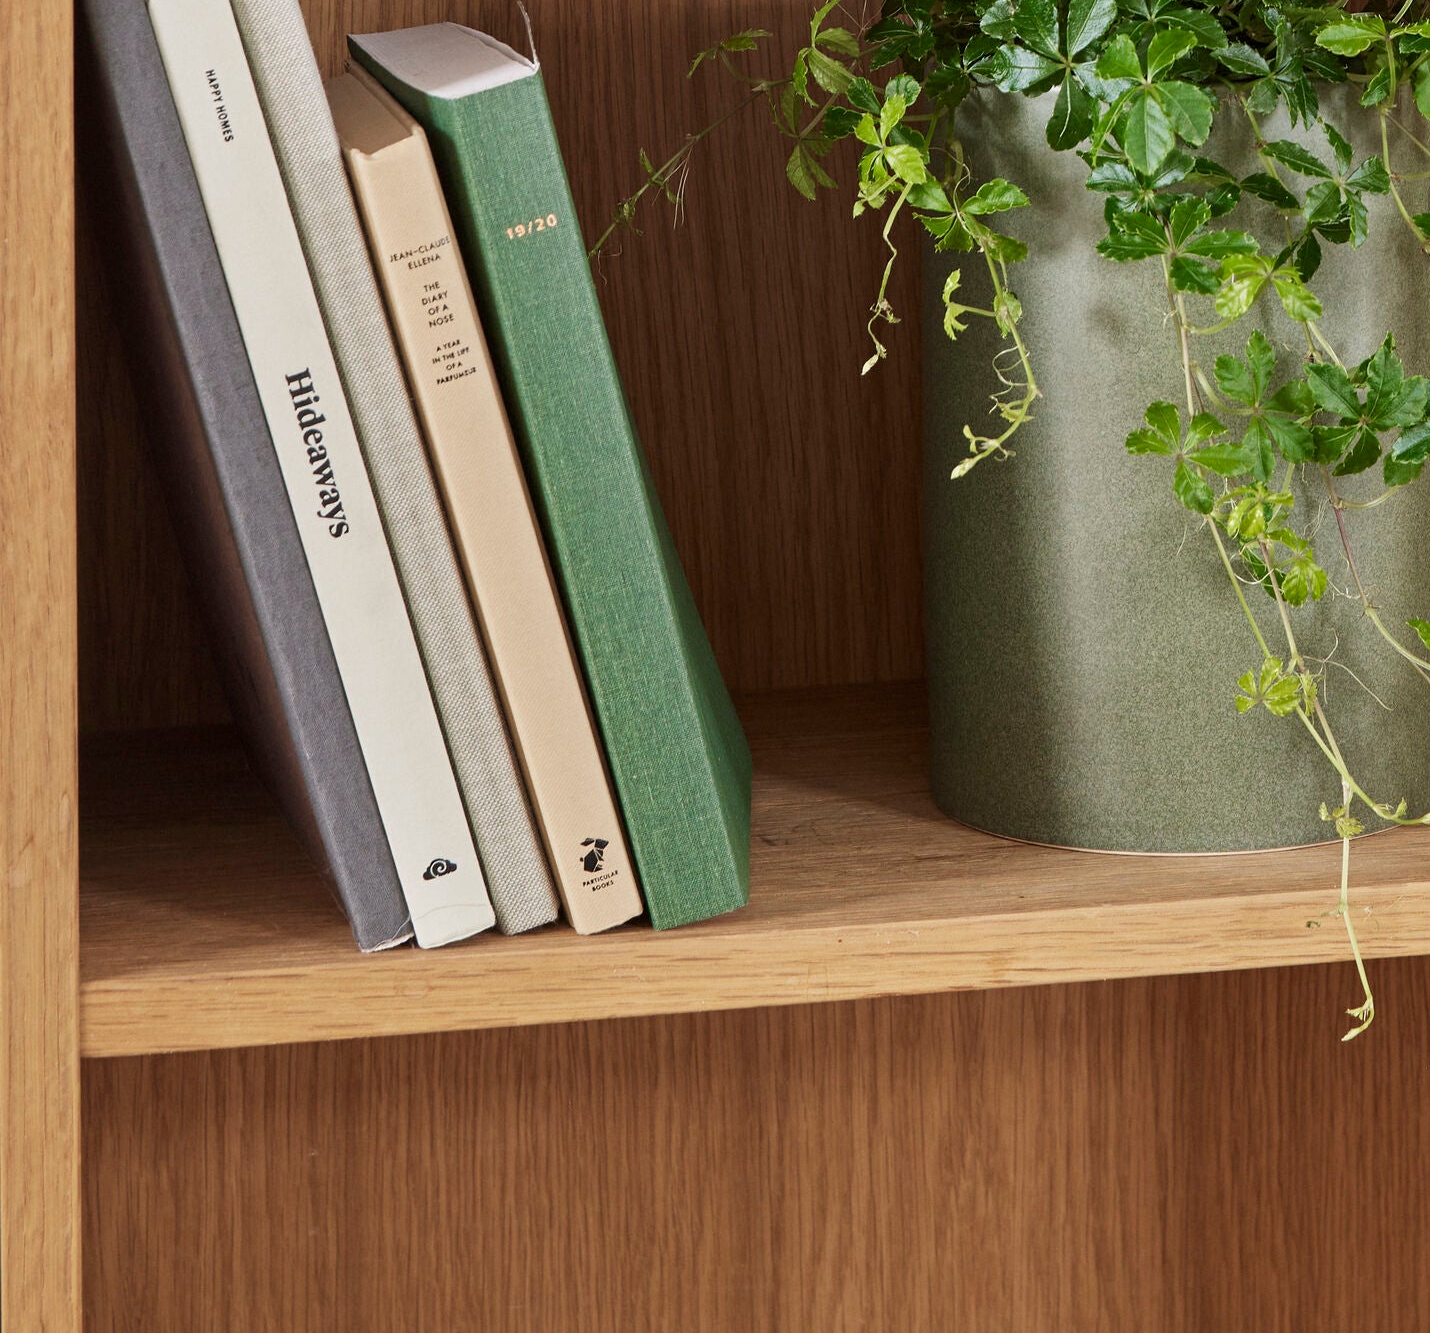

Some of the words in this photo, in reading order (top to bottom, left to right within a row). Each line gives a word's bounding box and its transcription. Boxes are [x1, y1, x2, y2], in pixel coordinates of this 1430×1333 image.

[205, 69, 223, 102] HAPPY
[216, 104, 234, 142] HOMES
[506, 213, 557, 240] 19/20
[389, 235, 451, 263] JEAN-CLAUDE
[408, 254, 441, 270] ELLENA
[423, 281, 440, 293] THE
[421, 290, 448, 306] DIARY
[428, 306, 439, 316] OF
[442, 304, 449, 312] A
[428, 313, 454, 328] NOSE
[443, 339, 460, 349] YEAR
[442, 352, 455, 361] THE
[446, 362, 455, 371] OF
[285, 367, 349, 538] Hideaways
[582, 870, 618, 887] PARTICULAR
[592, 880, 614, 892] BOOKS
